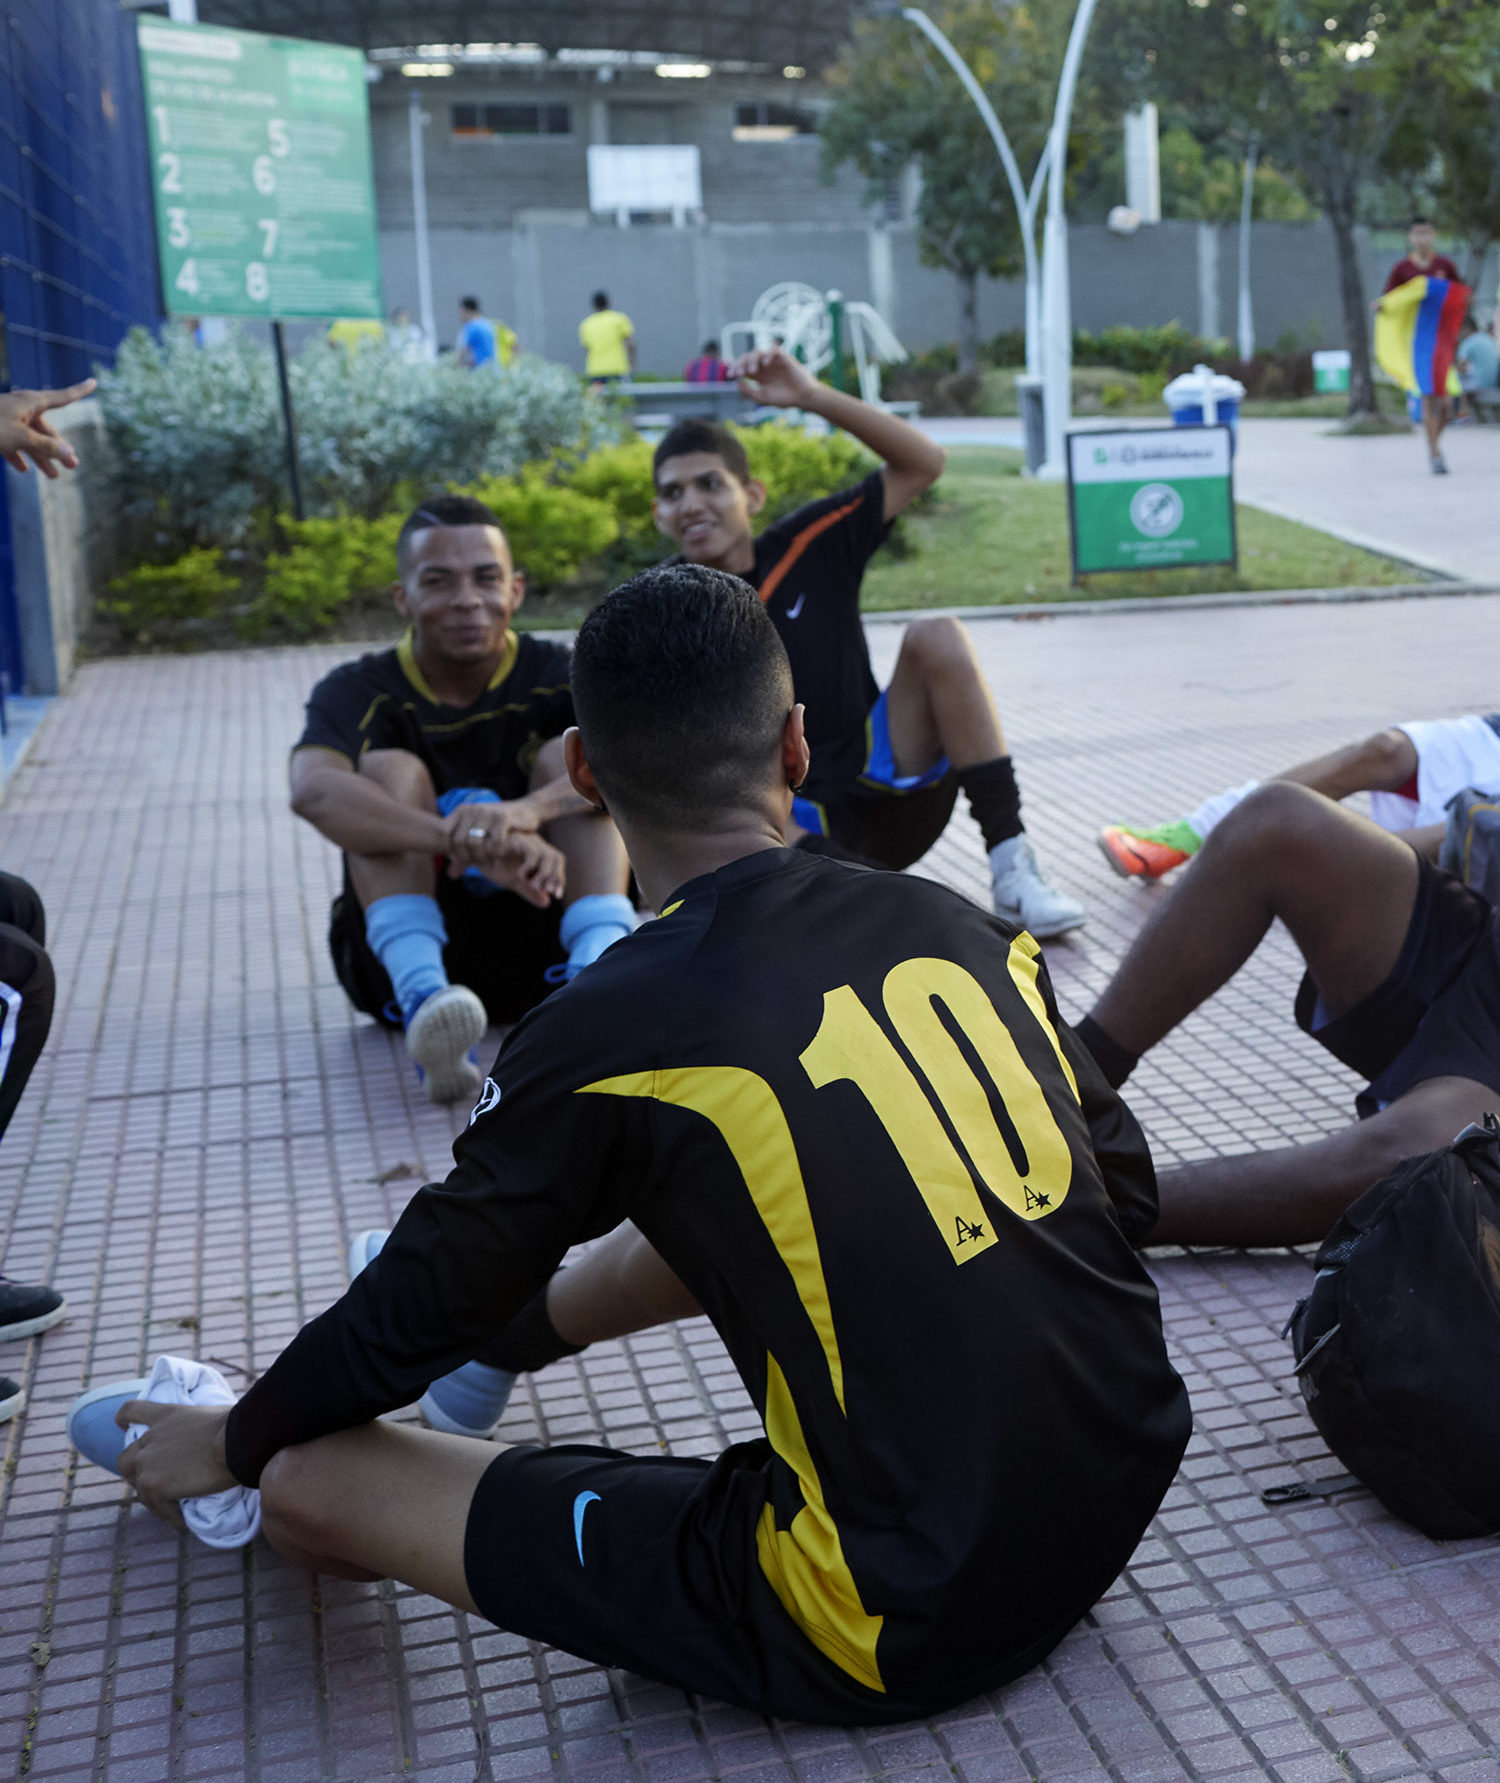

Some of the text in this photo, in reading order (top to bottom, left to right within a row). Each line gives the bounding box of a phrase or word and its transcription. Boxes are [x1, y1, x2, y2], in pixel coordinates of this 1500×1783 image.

[154, 105, 171, 144] 1
[267, 119, 290, 157] 5
[158, 152, 182, 193] 2
[253, 156, 276, 194] 6
[166, 207, 190, 248] 3
[258, 219, 278, 258] 7
[175, 257, 199, 296] 4
[246, 261, 268, 301] 8
[798, 957, 1073, 1266] 10
